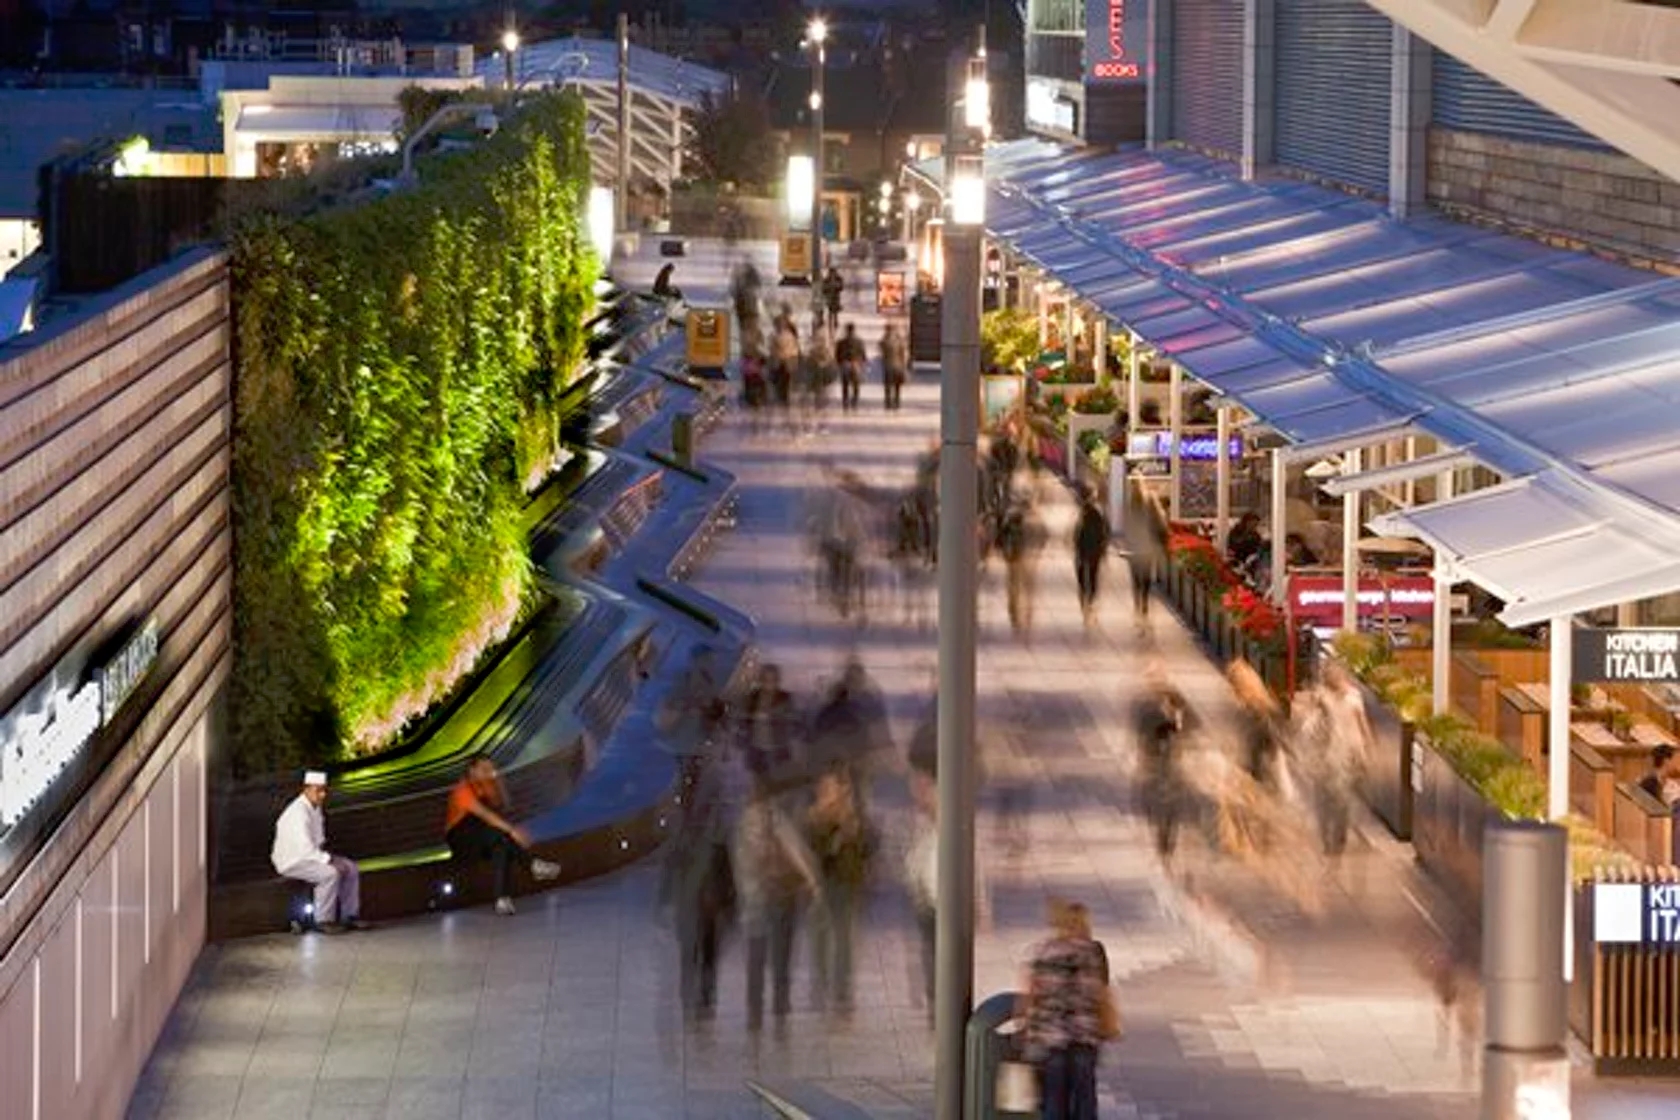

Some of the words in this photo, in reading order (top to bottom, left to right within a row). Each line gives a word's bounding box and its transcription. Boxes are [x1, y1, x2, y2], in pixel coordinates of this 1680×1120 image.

[1110, 0, 1124, 59] ES
[1094, 63, 1138, 76] BOOKS
[1606, 632, 1678, 652] KITCHEN
[1606, 653, 1678, 678] ITALIA
